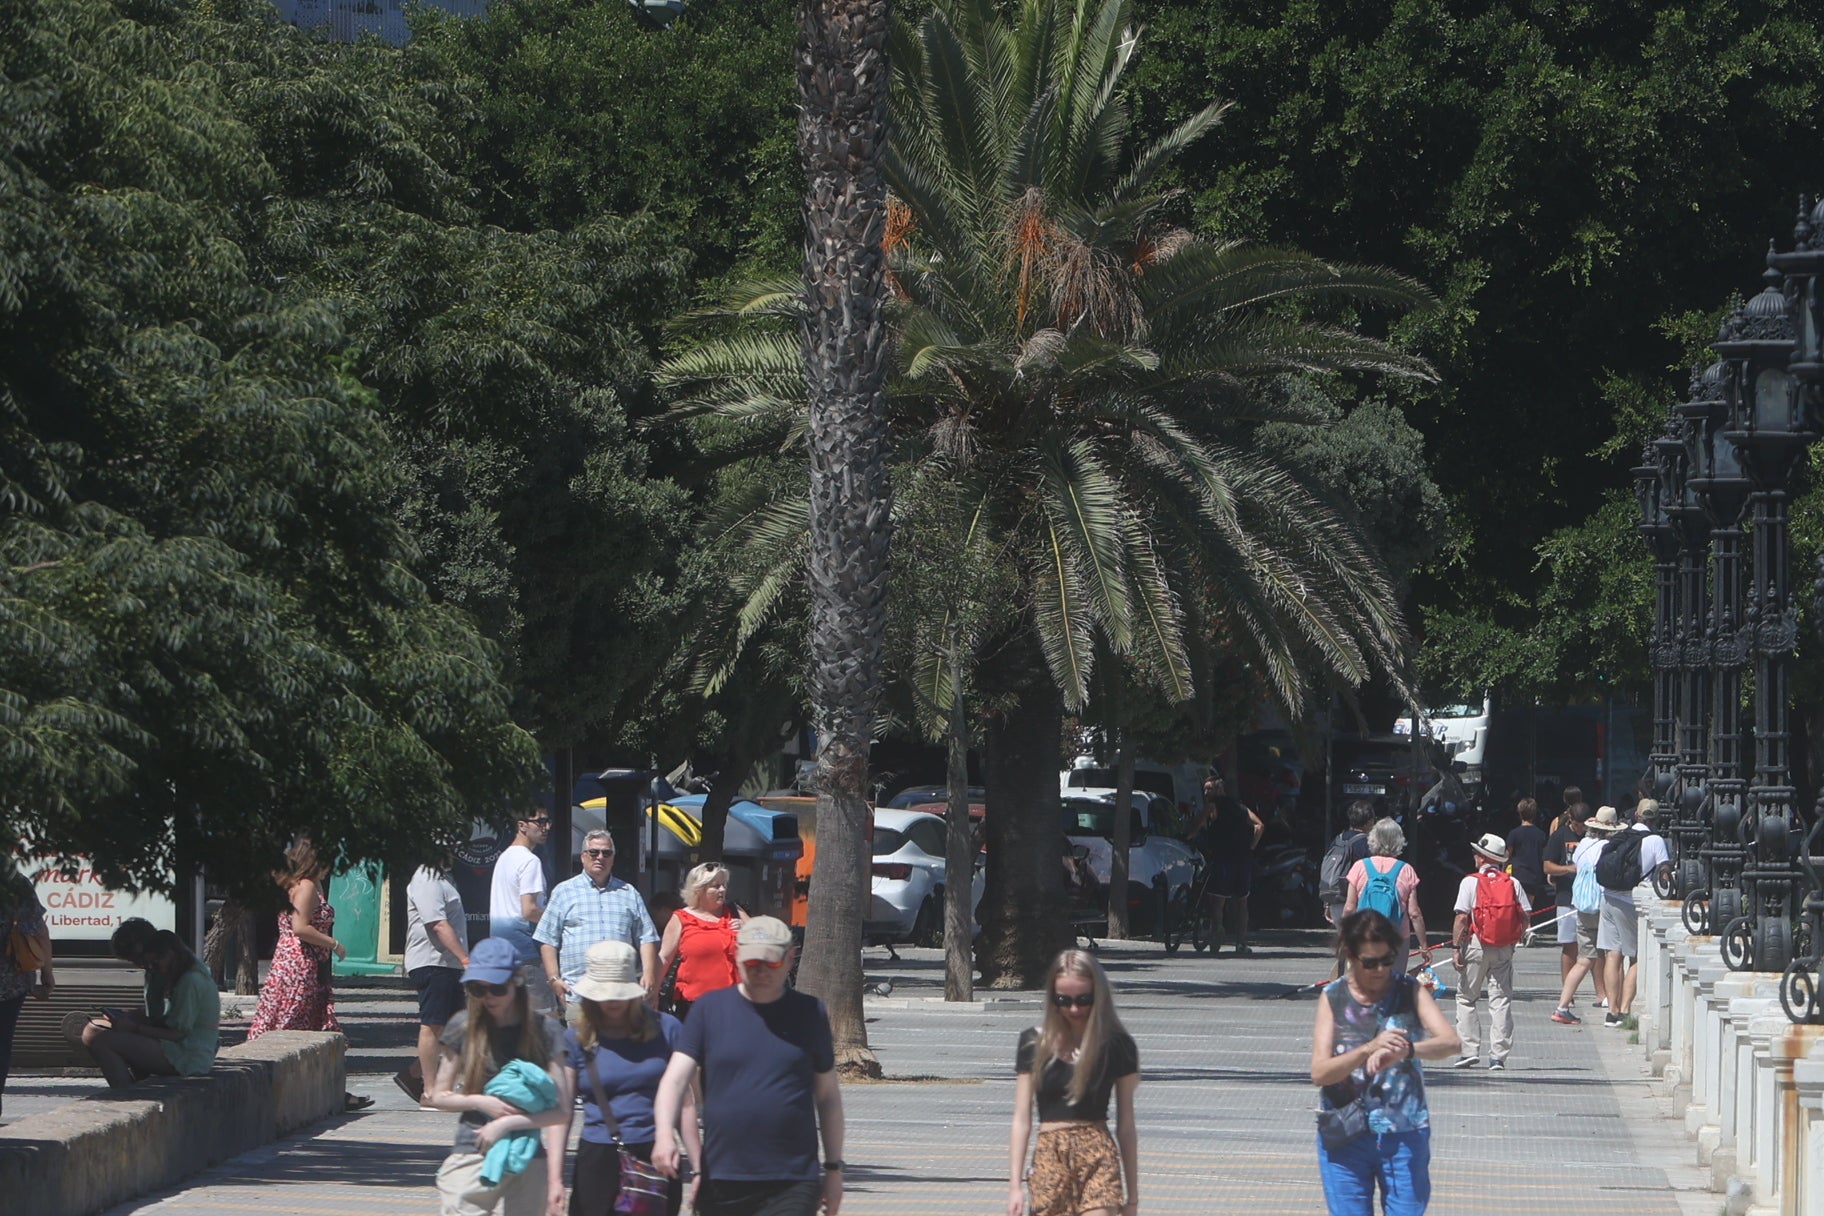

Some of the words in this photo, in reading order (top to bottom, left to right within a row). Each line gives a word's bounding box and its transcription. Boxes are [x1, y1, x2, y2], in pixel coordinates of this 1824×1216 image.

[35, 868, 104, 887] mark
[47, 887, 115, 909] CÁDIZ
[51, 915, 113, 928] Libertad,
